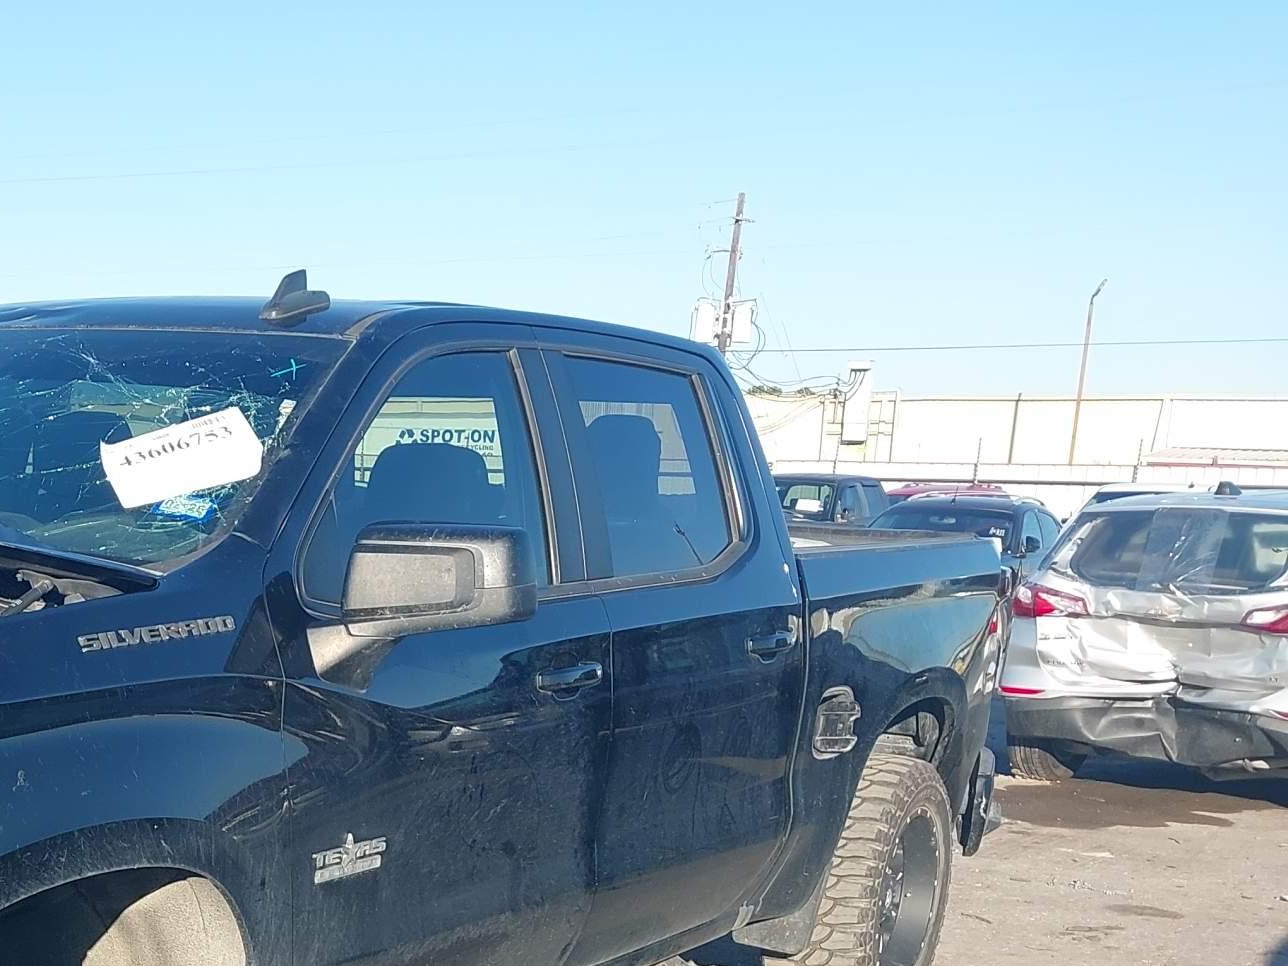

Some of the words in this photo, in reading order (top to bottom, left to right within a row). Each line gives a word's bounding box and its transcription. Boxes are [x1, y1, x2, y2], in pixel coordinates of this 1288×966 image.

[119, 426, 233, 467] 43606753
[419, 428, 495, 443] SPOT-ON
[77, 615, 236, 653] SILVERADO
